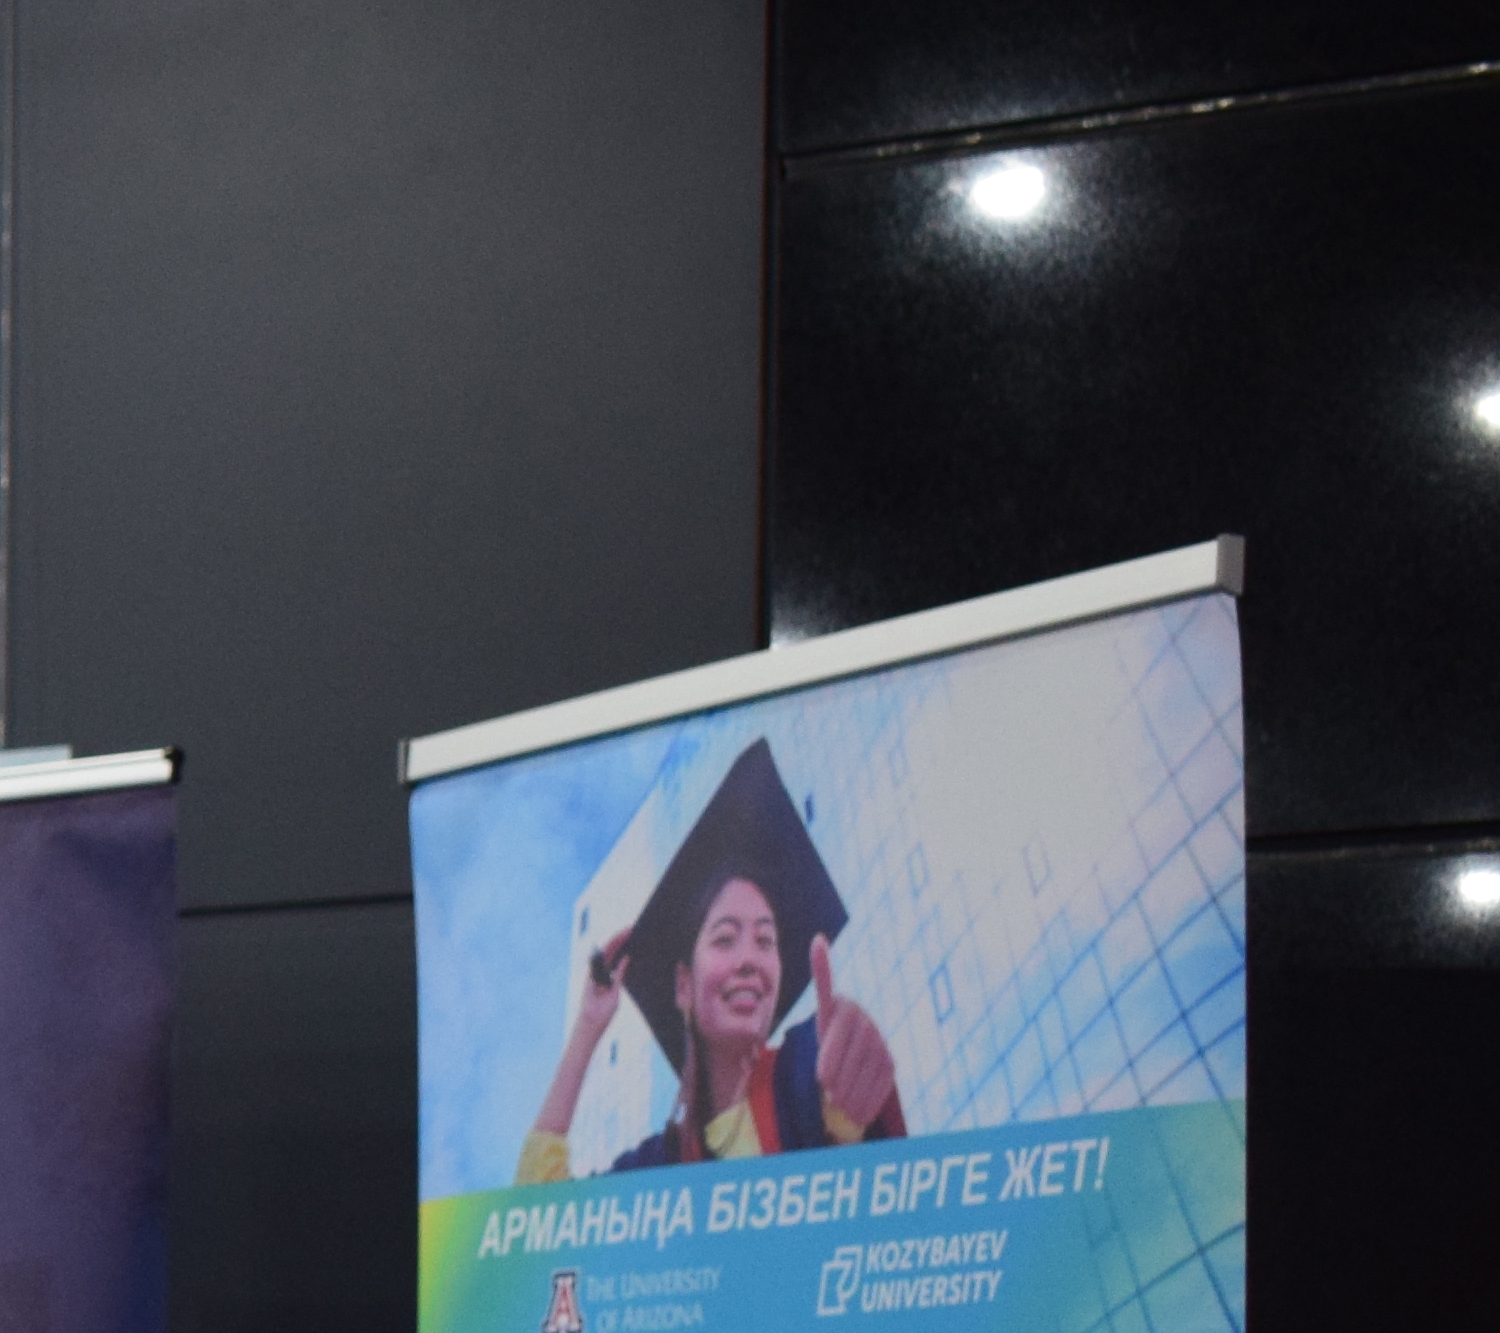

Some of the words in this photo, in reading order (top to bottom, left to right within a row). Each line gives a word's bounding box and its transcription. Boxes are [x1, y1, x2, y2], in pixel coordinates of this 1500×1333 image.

[477, 1186, 694, 1259] АРМАНЫҢА
[706, 1168, 862, 1235] БІЗБЕН
[869, 1151, 994, 1217] БІРГЕ
[1000, 1136, 1111, 1201] ЖЕТ!
[865, 1229, 1008, 1275] KOZYBAYEV
[587, 1275, 617, 1302] THE
[621, 1265, 723, 1299] UNIVERSITY
[860, 1270, 1002, 1313] UNIVERSITY
[621, 1303, 706, 1332] ARIZONA
